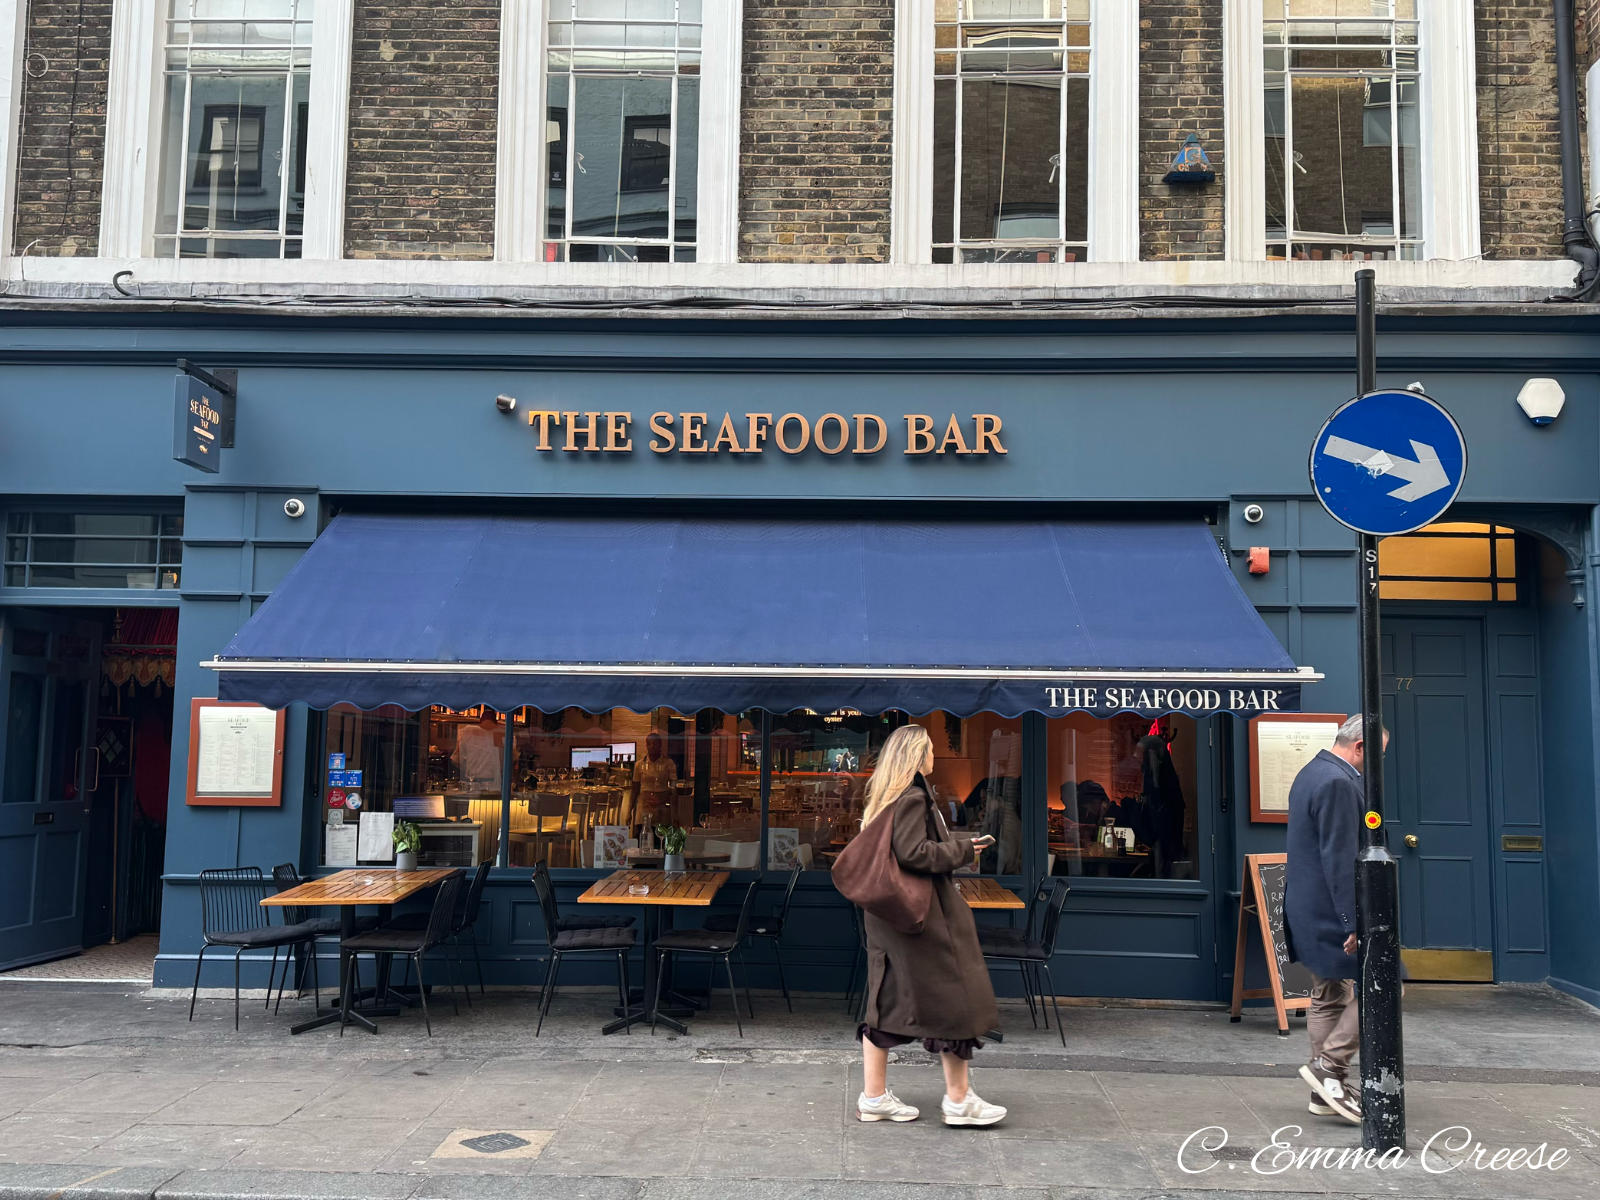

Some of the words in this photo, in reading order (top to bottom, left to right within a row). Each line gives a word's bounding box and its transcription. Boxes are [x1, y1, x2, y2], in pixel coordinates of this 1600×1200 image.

[190, 398, 220, 425] SEAFOOD
[527, 410, 633, 453] THE
[648, 411, 888, 455] SEAFOOD
[903, 412, 1008, 456] BAR
[1395, 677, 1413, 691] 77
[1045, 687, 1098, 708] THE
[1105, 687, 1221, 710] SEAFOOD
[1228, 689, 1282, 710] BAR
